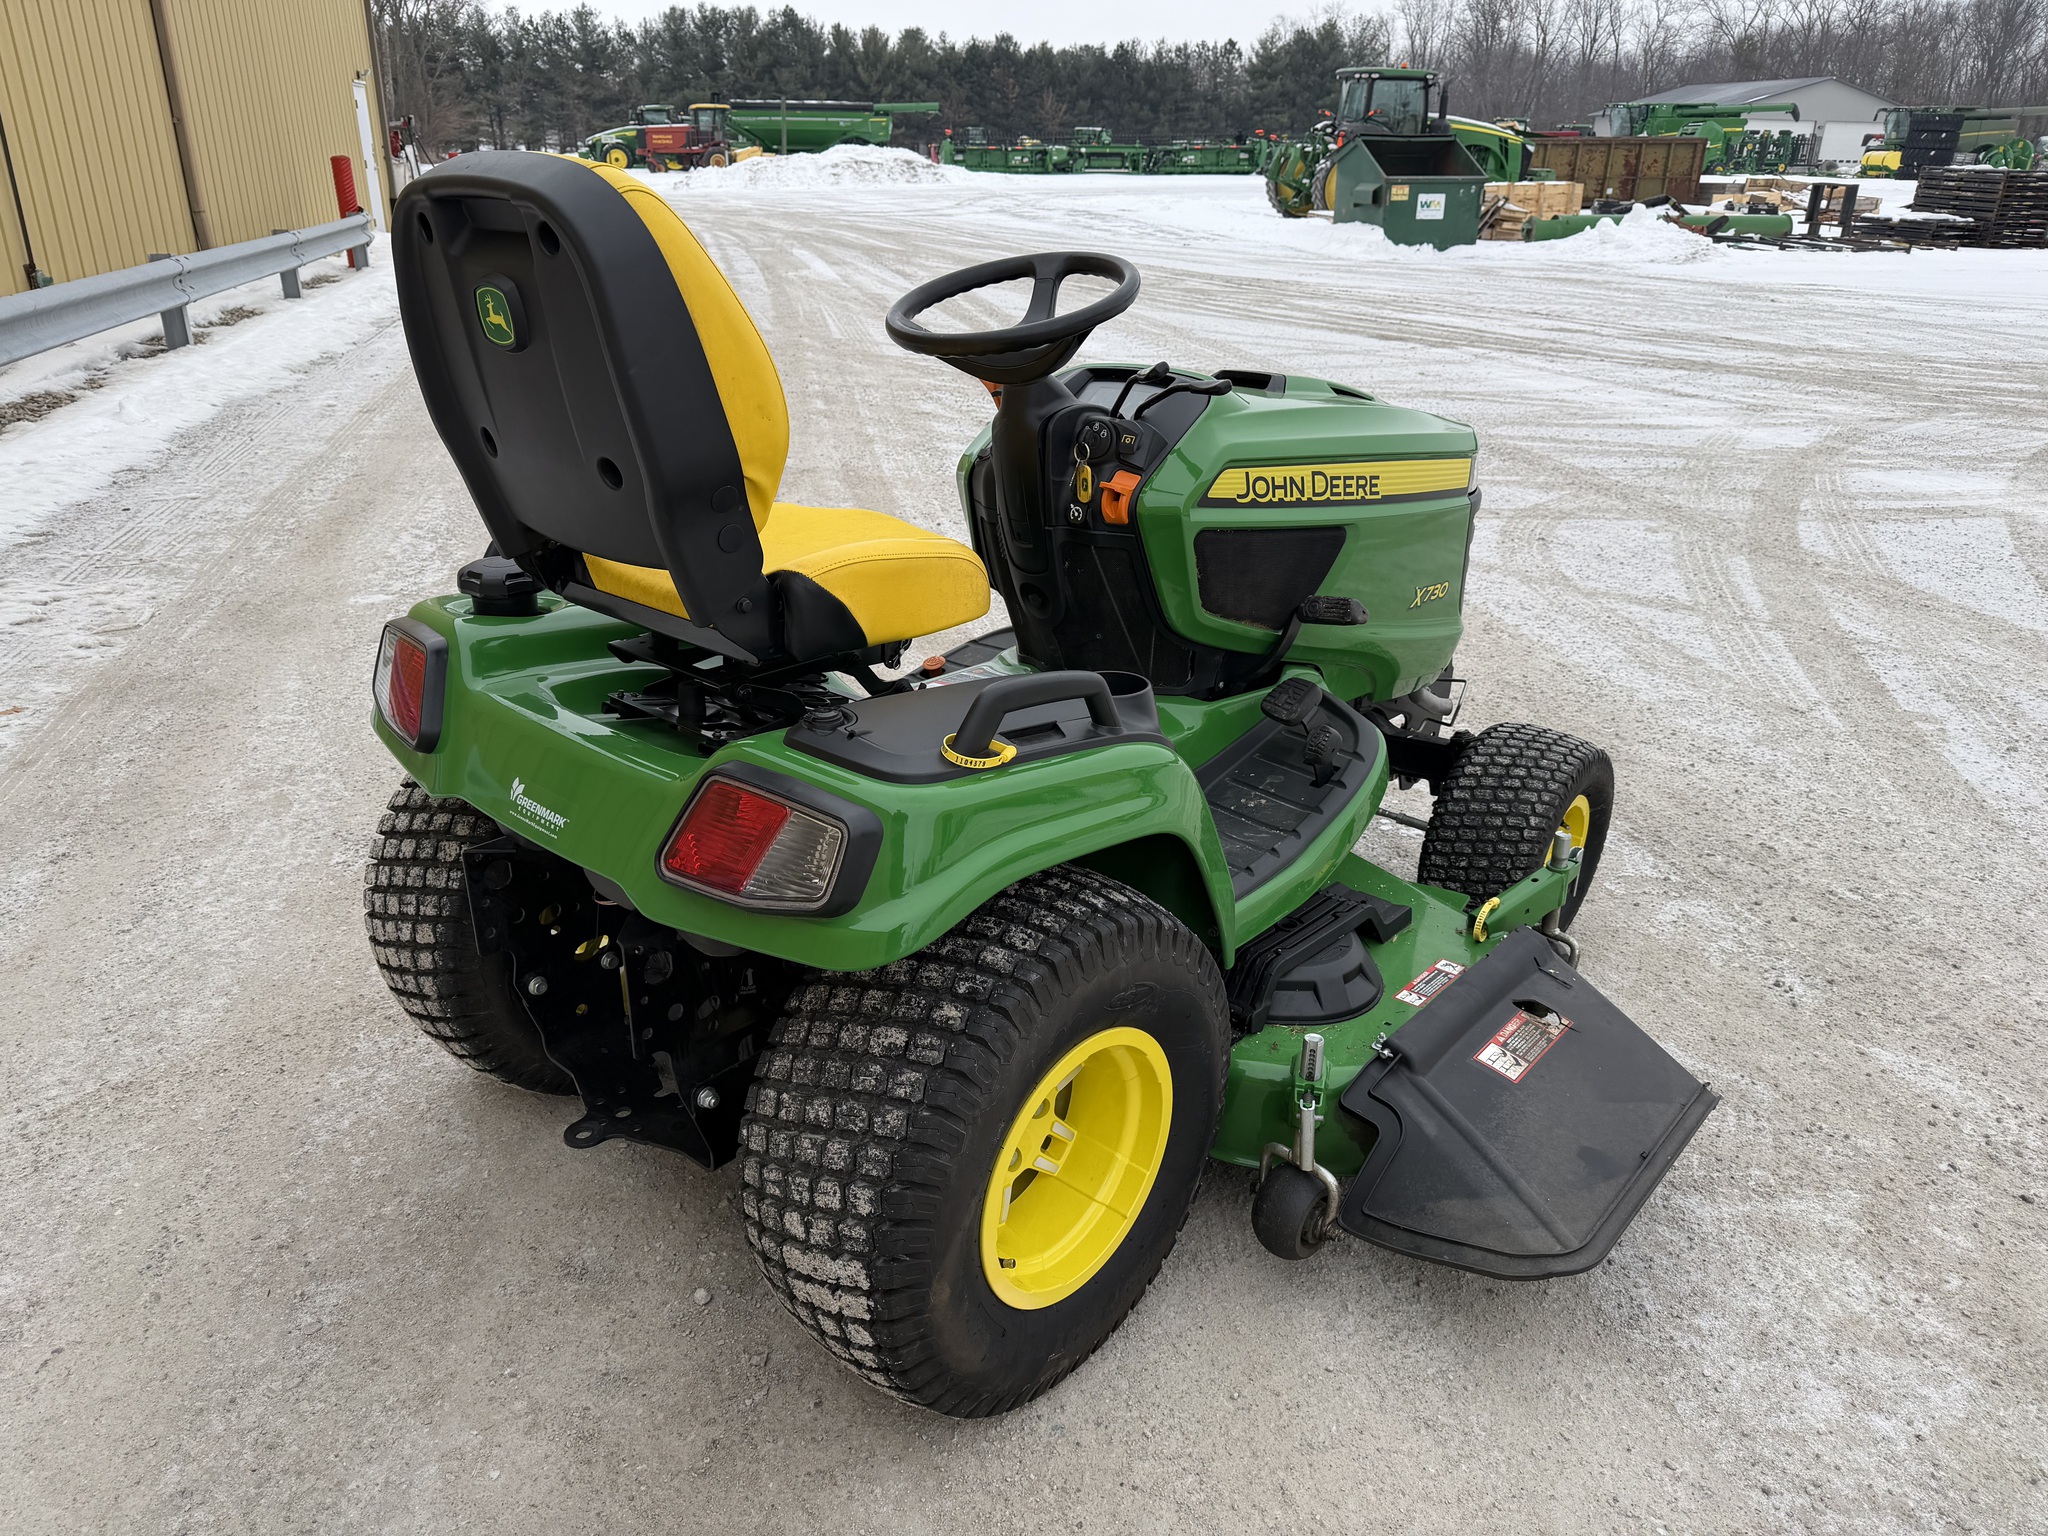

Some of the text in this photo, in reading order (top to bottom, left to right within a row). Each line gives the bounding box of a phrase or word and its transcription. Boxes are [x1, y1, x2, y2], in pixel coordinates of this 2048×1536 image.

[1236, 470, 1381, 502] JOHN DEERE
[1409, 581, 1449, 609] X730
[516, 794, 566, 828] GREENMARK
[518, 805, 559, 832] EQUIPMENT
[1500, 1018, 1523, 1038] DANGER
